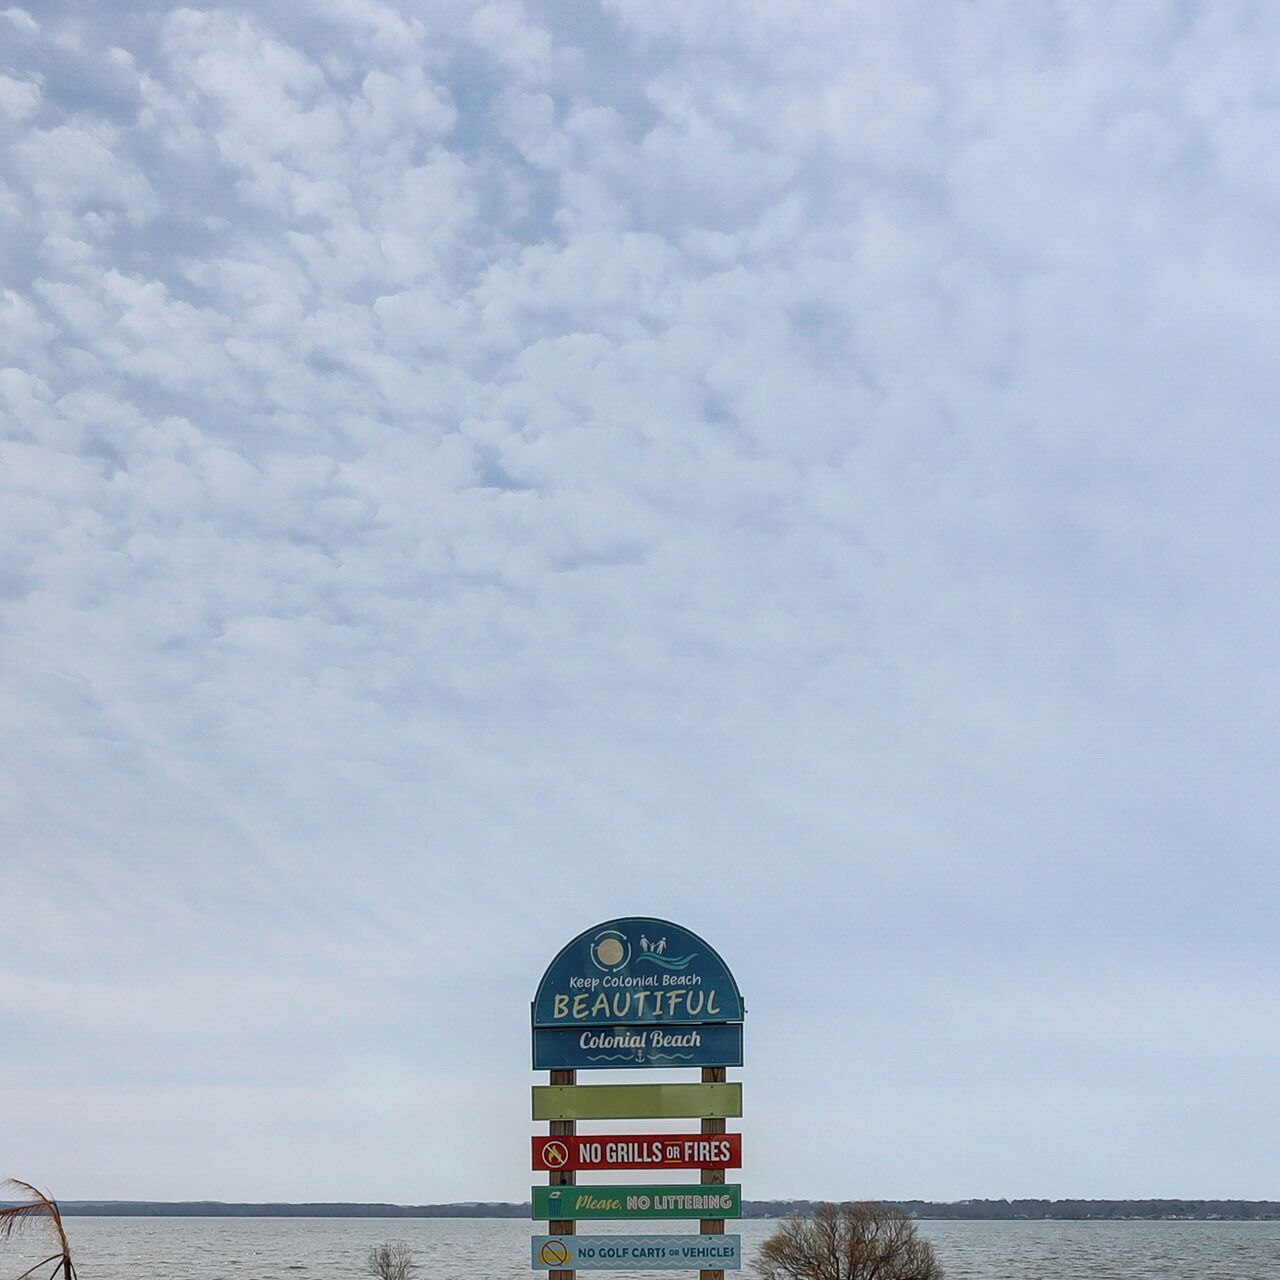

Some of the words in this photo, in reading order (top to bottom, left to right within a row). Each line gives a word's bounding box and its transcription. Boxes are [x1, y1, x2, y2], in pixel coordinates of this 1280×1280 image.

[570, 976, 600, 992] Keep
[602, 975, 658, 988] Colonial
[662, 974, 702, 987] Beach
[553, 990, 720, 1020] BEAUTIFUL
[579, 1031, 646, 1050] Colonial
[650, 1030, 702, 1048] Beach
[579, 1143, 602, 1163] NO
[606, 1142, 662, 1163] GRILLS
[666, 1146, 680, 1159] OR
[684, 1141, 731, 1162] FIRES
[626, 1195, 650, 1210] NO
[654, 1195, 732, 1209] LITTERING
[578, 1247, 596, 1258] NO
[598, 1247, 629, 1258] GOLF
[632, 1247, 666, 1258] CARTS
[669, 1249, 680, 1257] OR
[682, 1247, 735, 1257] VEHICLES
